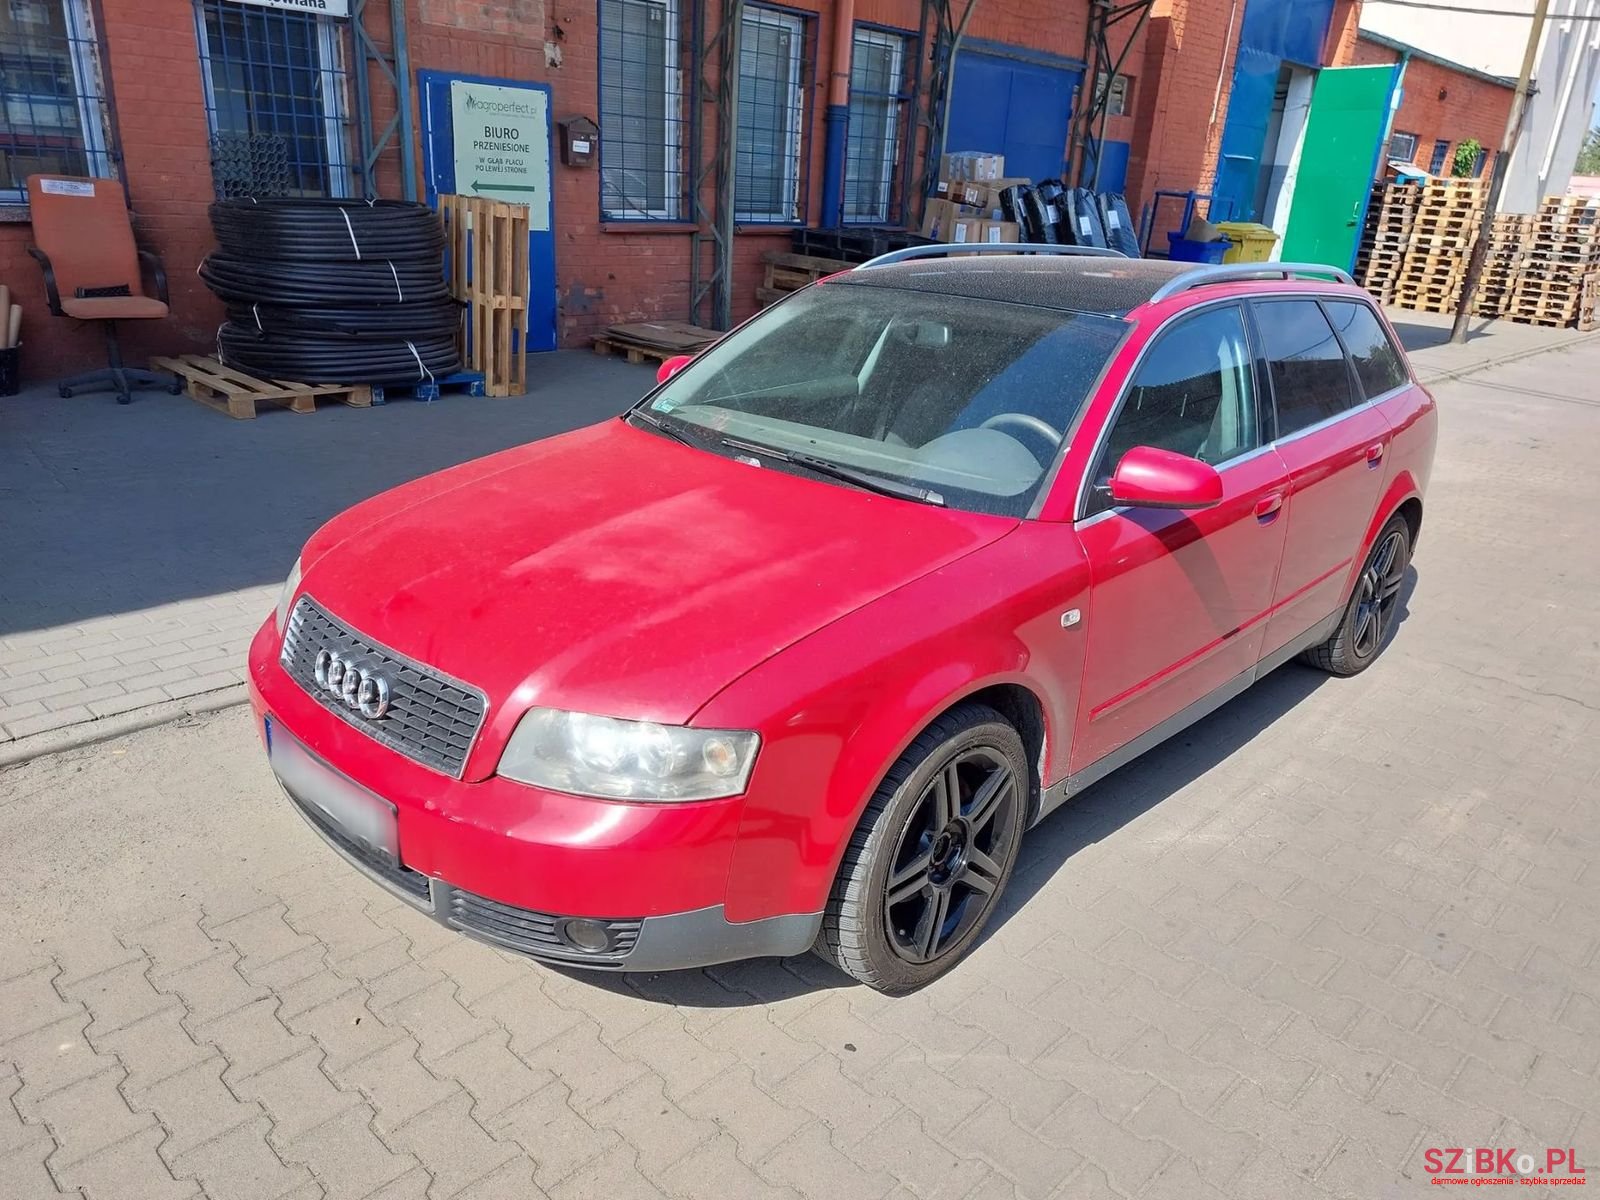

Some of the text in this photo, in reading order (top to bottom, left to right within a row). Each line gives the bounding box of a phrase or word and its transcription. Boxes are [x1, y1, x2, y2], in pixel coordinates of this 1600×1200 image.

[484, 125, 519, 140] BIURO
[473, 140, 530, 153] PRZENIESIONE
[505, 158, 524, 166] PLACU
[475, 164, 528, 174] PO LEWEJ STRONIE
